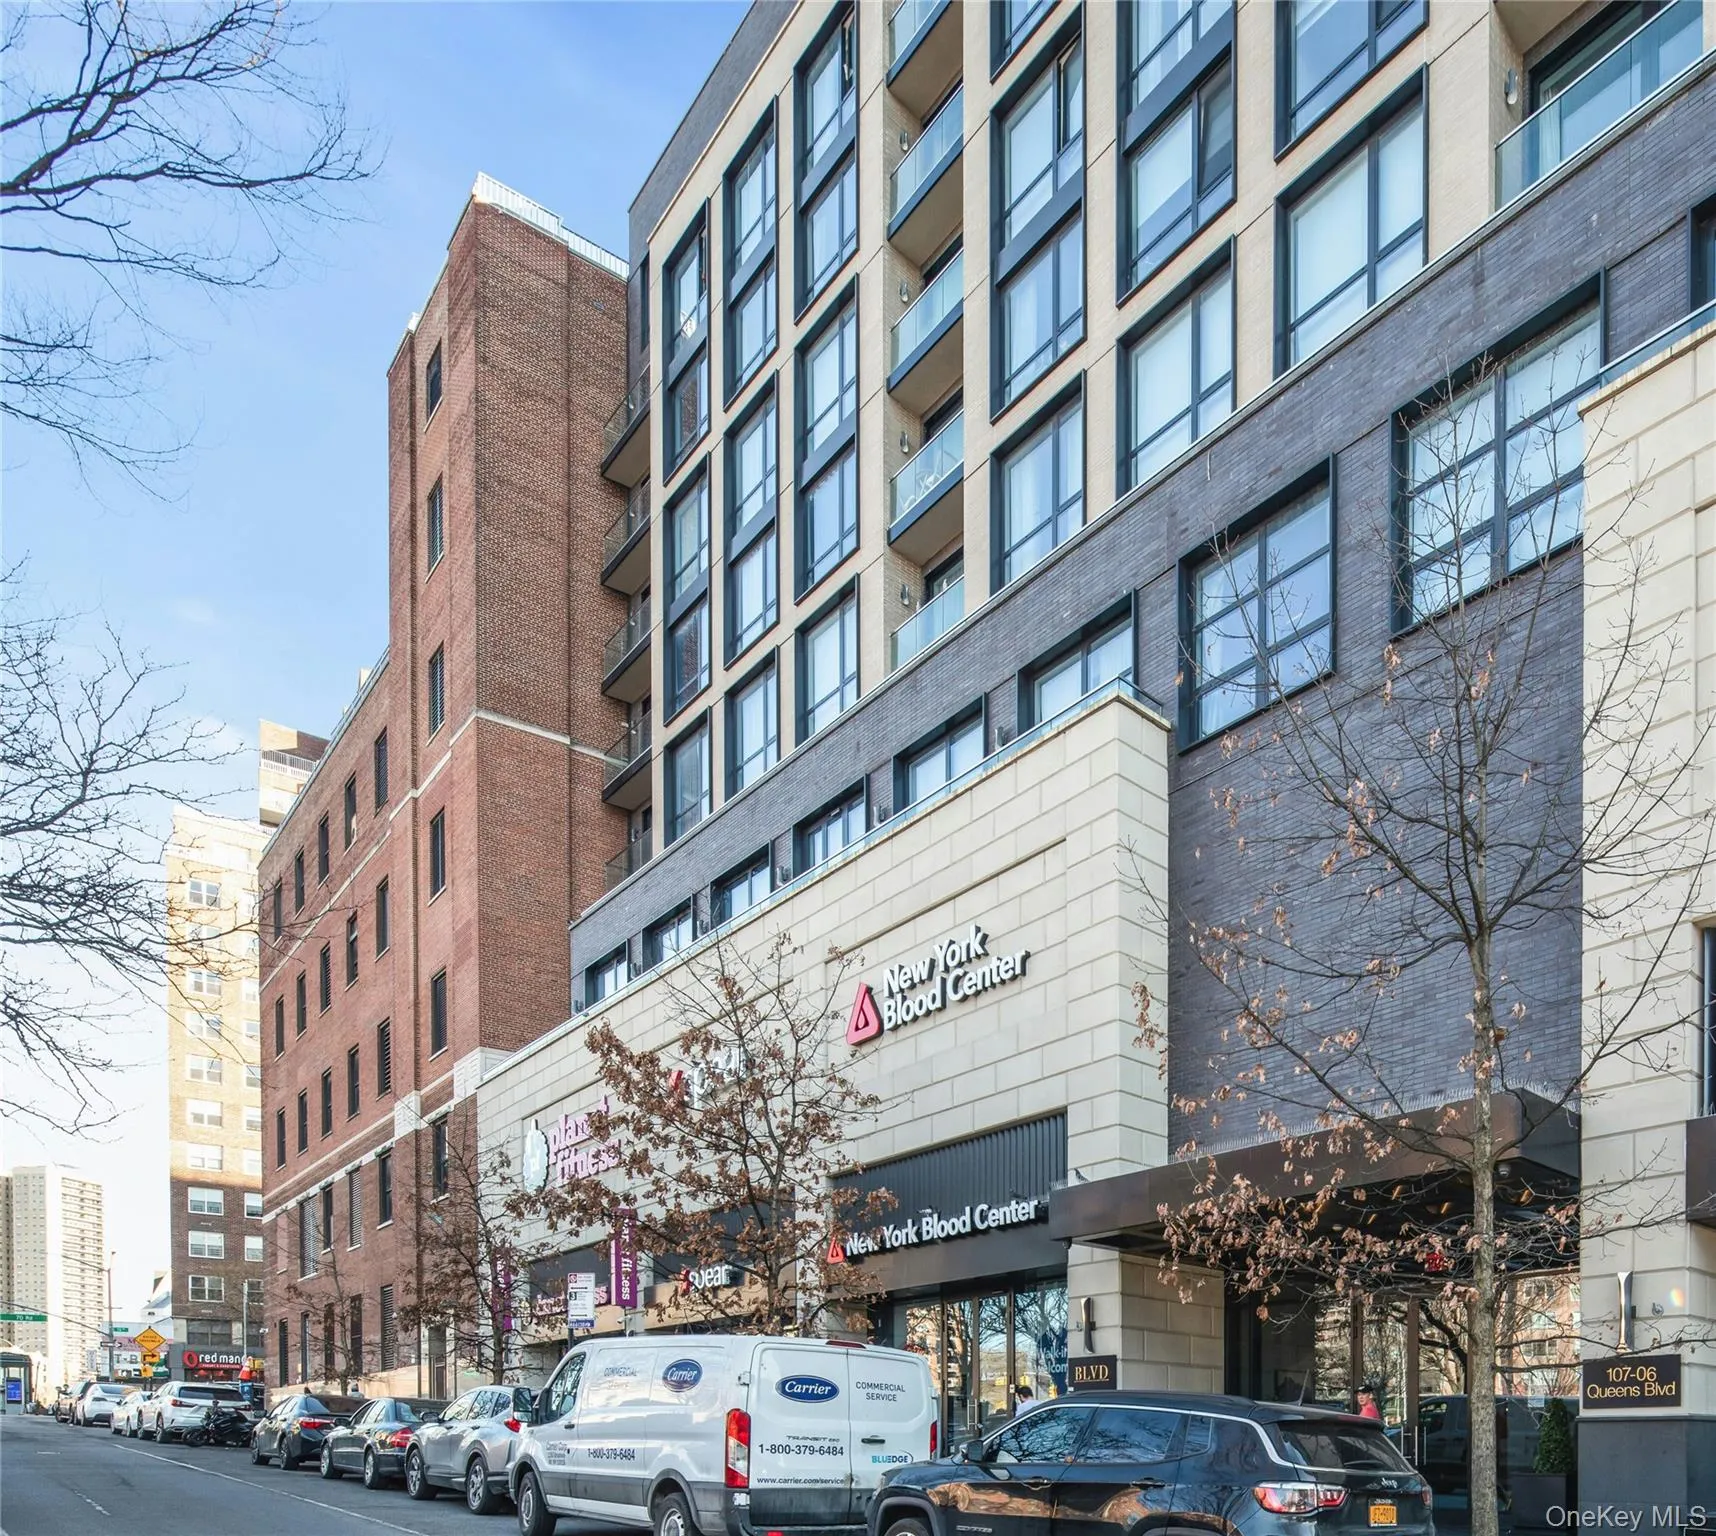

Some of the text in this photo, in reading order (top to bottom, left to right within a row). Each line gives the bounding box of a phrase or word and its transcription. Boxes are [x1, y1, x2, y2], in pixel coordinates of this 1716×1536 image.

[883, 923, 988, 997] New York
[883, 949, 1030, 1031] Blood Center
[845, 1199, 1039, 1257] New York Blood Center
[199, 1352, 218, 1363] red
[667, 1367, 698, 1383] Carrier
[1074, 1365, 1109, 1381] BLVD
[1606, 1366, 1657, 1383] 107-06
[784, 1380, 832, 1396] Carrier
[855, 1381, 906, 1393] COMMERCIAL
[1587, 1381, 1676, 1399] Queens Blvd
[865, 1392, 898, 1402] SERVICE
[587, 1447, 636, 1461] 1-800-379-6484
[758, 1444, 844, 1456] 1-800-379-6484
[871, 1455, 909, 1464] BLUEDGE
[757, 1476, 845, 1485] www.carrier.com/service
